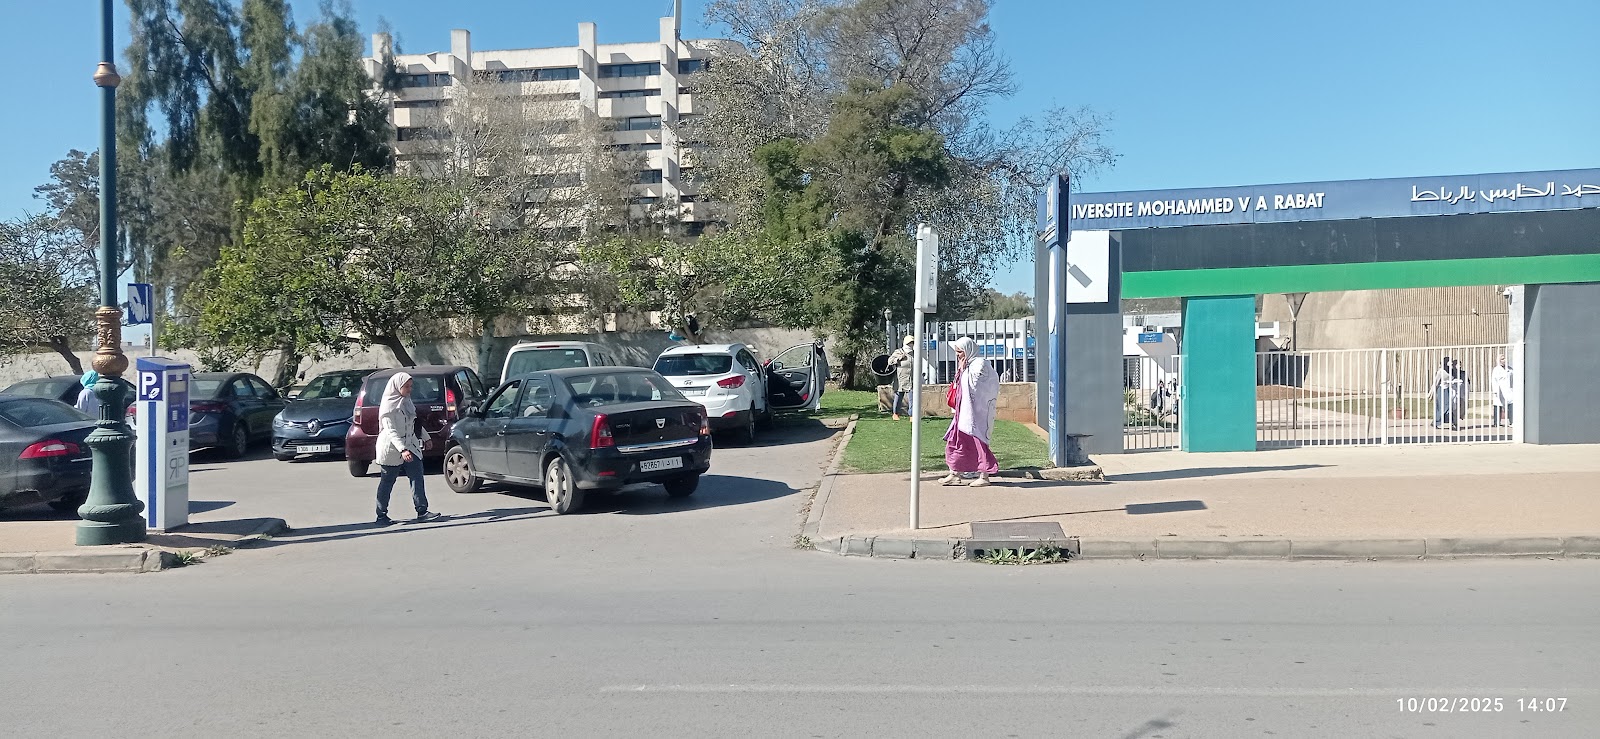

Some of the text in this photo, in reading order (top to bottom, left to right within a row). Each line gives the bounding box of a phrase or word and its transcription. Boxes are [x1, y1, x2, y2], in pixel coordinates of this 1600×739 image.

[1411, 181, 1600, 205] حمد الخامس بالرباط
[1072, 192, 1326, 219] IVERSITE MOHAMMED V A RABAT
[141, 372, 157, 396] P
